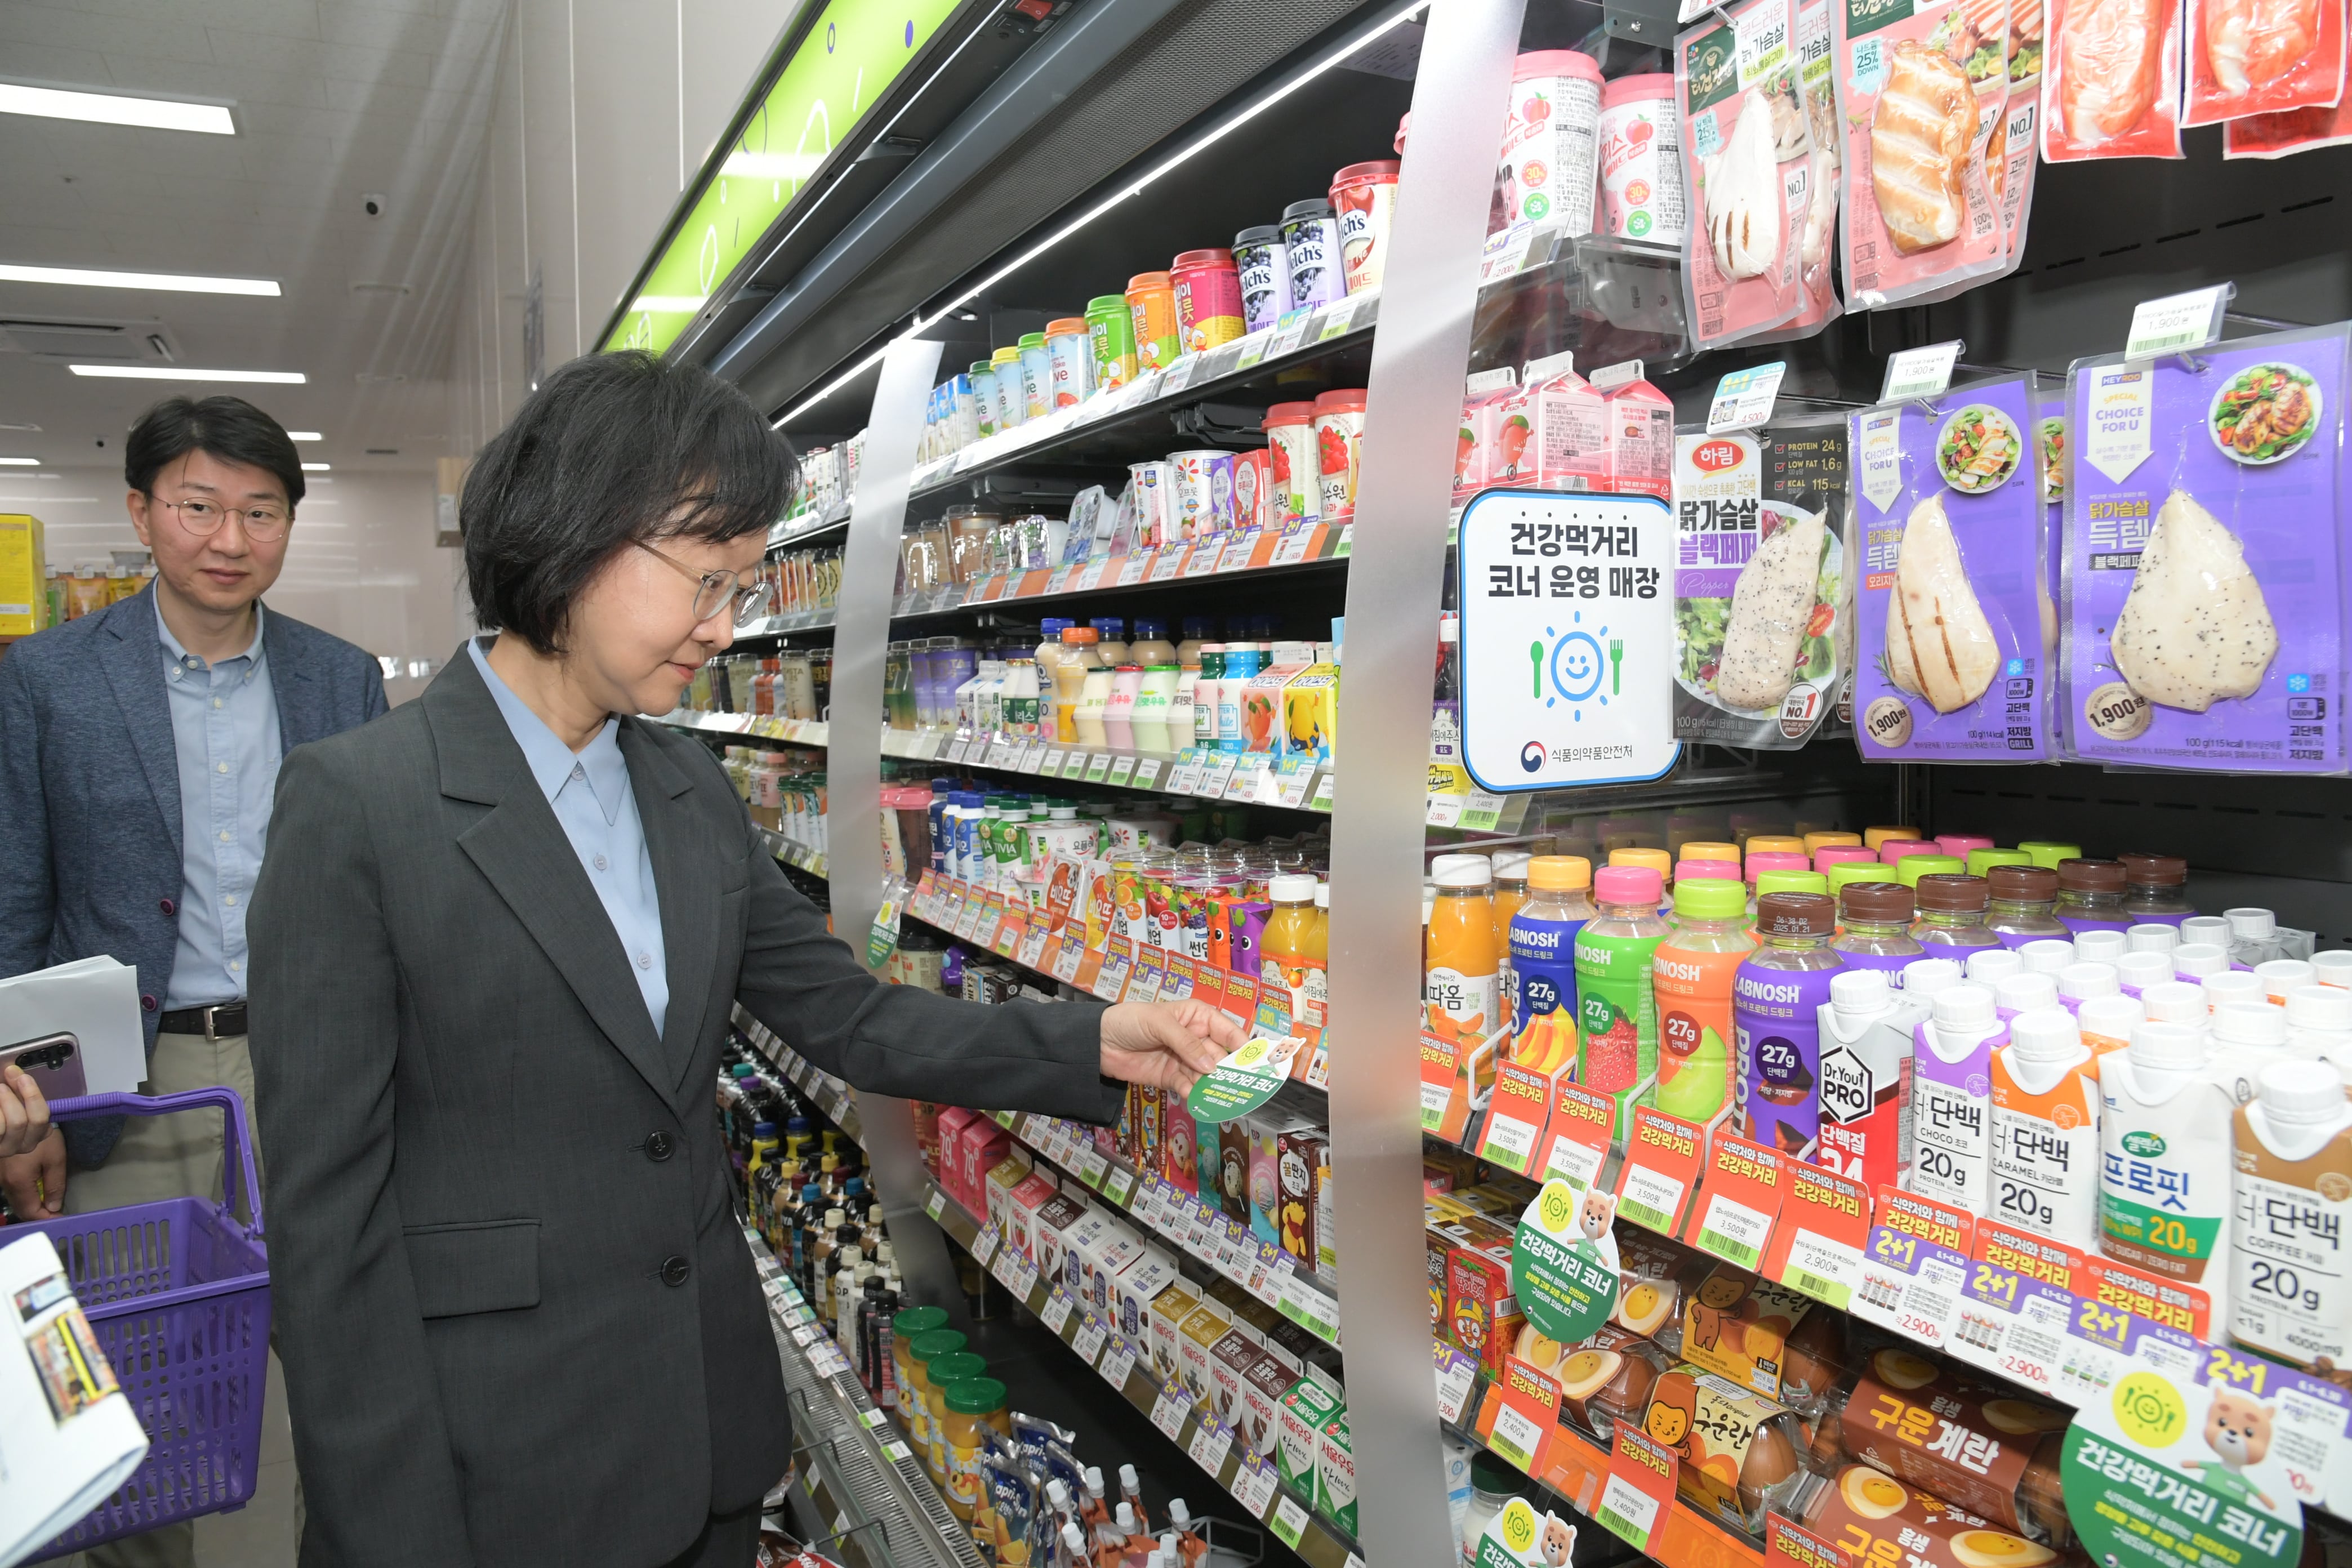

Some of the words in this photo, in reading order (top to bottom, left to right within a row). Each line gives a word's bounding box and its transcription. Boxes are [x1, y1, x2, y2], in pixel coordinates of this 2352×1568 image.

[1740, 2, 1784, 39] 부드러운
[1856, 52, 1879, 69] 25%
[1857, 64, 1879, 76] DOWN
[2010, 106, 2034, 138] NO.1
[1525, 167, 1545, 179] 30%
[1787, 170, 1807, 196] NO.1
[1904, 366, 1935, 377] 1,900원
[2103, 373, 2141, 385] HEYROO
[1723, 374, 1750, 393] 1+1
[1507, 404, 1520, 413] PEACH
[2104, 393, 2139, 404] SPECIAL
[1868, 418, 1892, 430] HEYROO
[2096, 407, 2144, 420] CHOICE
[2102, 422, 2126, 433] FOR
[2129, 420, 2139, 430] U
[1869, 435, 1891, 446] SPECIAL
[1700, 446, 1734, 466] 하림
[1865, 448, 1895, 461] CHOICE
[1869, 459, 1886, 471] FOR
[1886, 459, 1892, 469] U
[1720, 483, 1735, 496] 촉촉한
[1737, 479, 1756, 496] 고단백
[1679, 498, 1758, 532] 닭가슴살
[2090, 500, 2150, 519] 닭가슴살
[1286, 520, 1299, 533] 2+1
[1868, 528, 1903, 545] 닭가슴살
[2089, 519, 2150, 550] 득템
[1511, 522, 1638, 557] 건강먹거리
[1488, 565, 1541, 598] 코너
[1550, 565, 1600, 599] 운영
[1610, 568, 1660, 599] 매장
[2006, 703, 2030, 713] 고단백
[2089, 696, 2145, 728] 1,900원
[1868, 709, 1907, 737] 1,900원
[2007, 727, 2032, 737] 저지방
[2289, 725, 2324, 737] 고단백
[1552, 746, 1633, 763] 식품의약품안전처
[2008, 740, 2033, 749] GRILL
[2289, 749, 2324, 760] 저지방
[1773, 924, 1810, 933] 2025.01.21
[1534, 951, 1553, 959] 드링크
[1165, 974, 1179, 989] 2+1
[1227, 983, 1253, 1001] 건강먹거리
[1529, 983, 1554, 1001] 27g
[1734, 974, 1799, 1004] LABNOSH
[1429, 983, 1464, 1010] 따옴
[1533, 1001, 1549, 1010] 단백질
[1585, 1000, 1609, 1021] 27g
[1749, 1002, 1769, 1015] 프로틴
[1770, 1006, 1793, 1018] 드링크
[1588, 1021, 1603, 1030] 단백질
[1668, 1018, 1695, 1042] 27g
[1442, 1043, 1454, 1055] 함께
[1672, 1039, 1689, 1050] 단백질
[1762, 1045, 1796, 1068] 27g
[1505, 1067, 1529, 1083] 식약처와
[1529, 1074, 1543, 1088] 함께
[1767, 1066, 1788, 1078] 단백질
[1824, 1063, 1859, 1087] Dr.You
[1502, 1078, 1544, 1104] 건강먹거리
[1565, 1087, 1591, 1105] 식약처와
[1591, 1095, 1606, 1110] 함께
[1823, 1080, 1865, 1109] PRO
[1560, 1098, 1607, 1127] 건강먹거리
[1646, 1113, 1675, 1133] 식약처와
[1675, 1122, 1693, 1141] 함께
[1920, 1127, 1953, 1146] CHOCO
[1498, 1134, 1517, 1146] 3,500원
[1640, 1124, 1694, 1157] 건강먹거리
[1820, 1125, 1866, 1156] 단백질
[1723, 1140, 1756, 1160] 식약처와
[1757, 1151, 1776, 1168] 함께
[1282, 1161, 1306, 1185] 꿀딴지
[1560, 1158, 1581, 1173] 3,500원
[1717, 1152, 1777, 1187] 건강먹거리
[1992, 1158, 2039, 1181] CARAMEL
[1143, 1171, 1158, 1189] 2+1
[1797, 1166, 1834, 1190] 식약처와
[1834, 1179, 1856, 1197] 함께
[1919, 1173, 1945, 1188] PROTEIN
[2103, 1151, 2190, 1212] 프로핏
[1637, 1188, 1660, 1204] 3,500원
[1793, 1178, 1860, 1218] 건강먹거리
[1952, 1199, 1968, 1208] BCAA
[1198, 1204, 1214, 1222] 2+1
[1891, 1196, 1934, 1220] 식약처와
[1935, 1209, 1958, 1228] 함께
[1999, 1211, 2029, 1226] PROTEIN
[1228, 1220, 1242, 1240] 2+1
[1720, 1219, 1747, 1237] 3,500원
[1886, 1209, 1961, 1250] 건강먹거리
[1260, 1242, 1279, 1262] 2+1
[1875, 1230, 1916, 1265] 2+1
[1992, 1231, 2039, 1257] 식약처와
[2041, 1244, 2068, 1267] 함께
[2247, 1236, 2302, 1259] COFFEE
[1520, 1230, 1583, 1280] 건강먹거리
[1580, 1266, 1612, 1297] 코너
[1805, 1252, 1839, 1274] 2,900원
[1985, 1244, 2071, 1290] 건강먹거리
[1553, 1276, 1569, 1291] 정하는
[1568, 1286, 1591, 1304] 안전하고
[1972, 1264, 2019, 1302] 2+1
[2104, 1268, 2157, 1299] 식약처와
[1531, 1287, 1551, 1304] 구성되어
[1550, 1298, 1571, 1317] 있습니다.
[1570, 1299, 1588, 1315] 등으로
[2097, 1281, 2195, 1335] 건강먹거리
[1153, 1320, 1175, 1343] 서울우유
[2078, 1300, 2130, 1343] 2+1
[1182, 1343, 1205, 1367] 서울우유
[1213, 1366, 1237, 1393] 서울우유
[1514, 1362, 1539, 1384] 식약처와
[1539, 1374, 1553, 1392] 함께
[1510, 1371, 1554, 1409] 건강먹거리
[1245, 1390, 1272, 1422] 서울우유
[1293, 1400, 1319, 1423] 서울우유
[1202, 1411, 1219, 1432] 2+1
[1280, 1411, 1312, 1446] 서울우유
[1502, 1418, 1526, 1440] 2,400원
[1694, 1407, 1752, 1450] 구운란
[1623, 1428, 1649, 1449] 식약처와
[1649, 1444, 1667, 1461] 함께
[1870, 1394, 1935, 1447] 구운
[1927, 1420, 1999, 1475] 계란
[1246, 1449, 1262, 1470] 2+1
[1321, 1441, 1355, 1477] 서울우유
[1619, 1438, 1671, 1478] 건강먹거리
[1613, 1496, 1637, 1518] 2,400원
[2075, 1437, 2219, 1524] 건강먹거리
[2216, 1505, 2287, 1557] 코너
[1779, 1524, 1815, 1550] 식약처와
[1816, 1544, 1837, 1564] 함께
